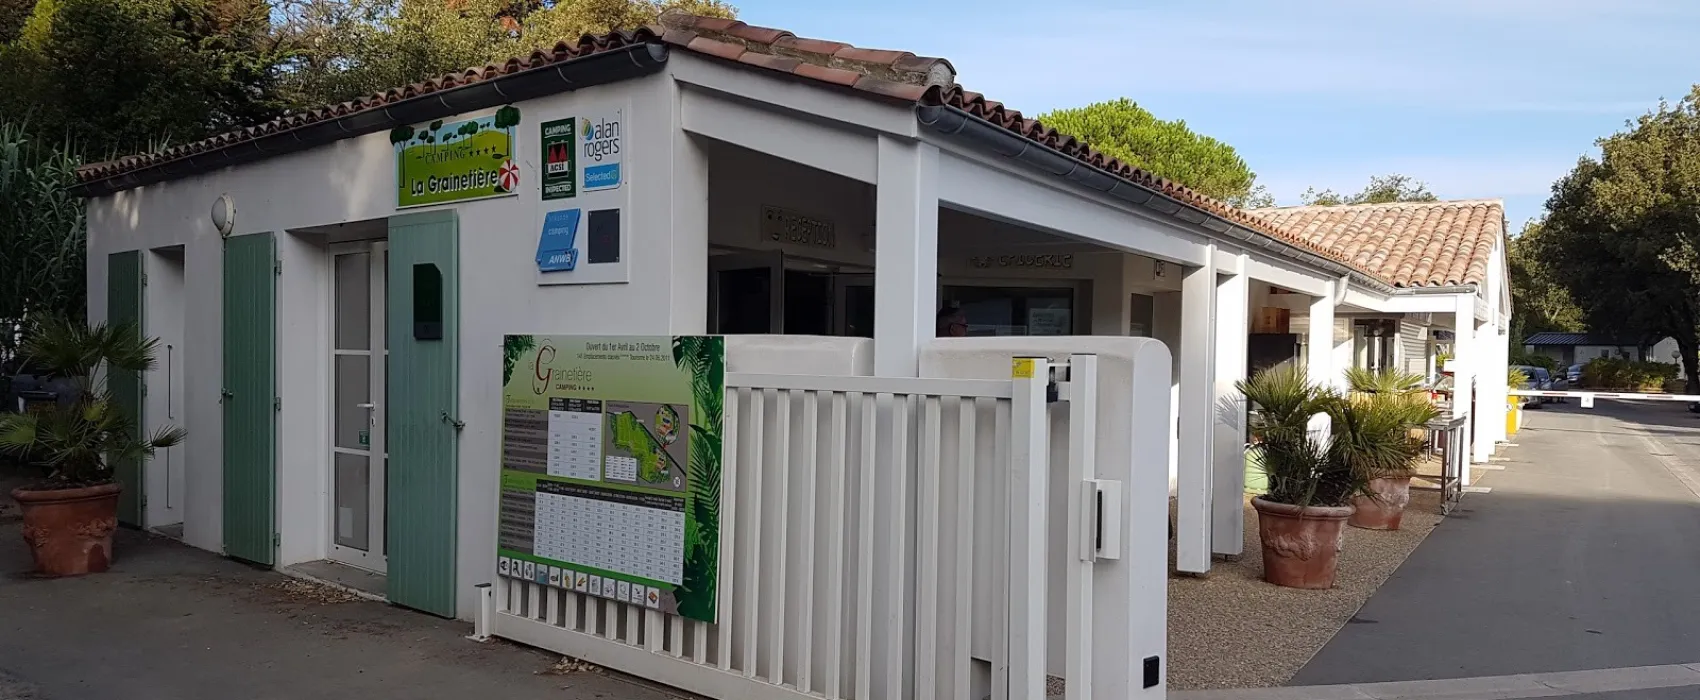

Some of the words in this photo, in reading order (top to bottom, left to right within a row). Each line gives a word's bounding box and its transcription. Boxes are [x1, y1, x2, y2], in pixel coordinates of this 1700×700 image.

[545, 124, 571, 136] CAMPING
[595, 118, 619, 139] alan
[584, 137, 620, 161] rogers
[425, 149, 465, 164] CAMPING
[550, 162, 565, 172] ACSI
[411, 178, 425, 196] La
[428, 167, 499, 194] Grainetière
[586, 171, 610, 182] Selected
[545, 184, 571, 194] INSPECTED
[548, 254, 571, 264] ANWB
[586, 342, 601, 352] Ouvert
[602, 342, 608, 351] du
[609, 342, 617, 352] 1er
[618, 342, 628, 352] Avril
[629, 343, 635, 352] au
[641, 342, 660, 352] Octobre
